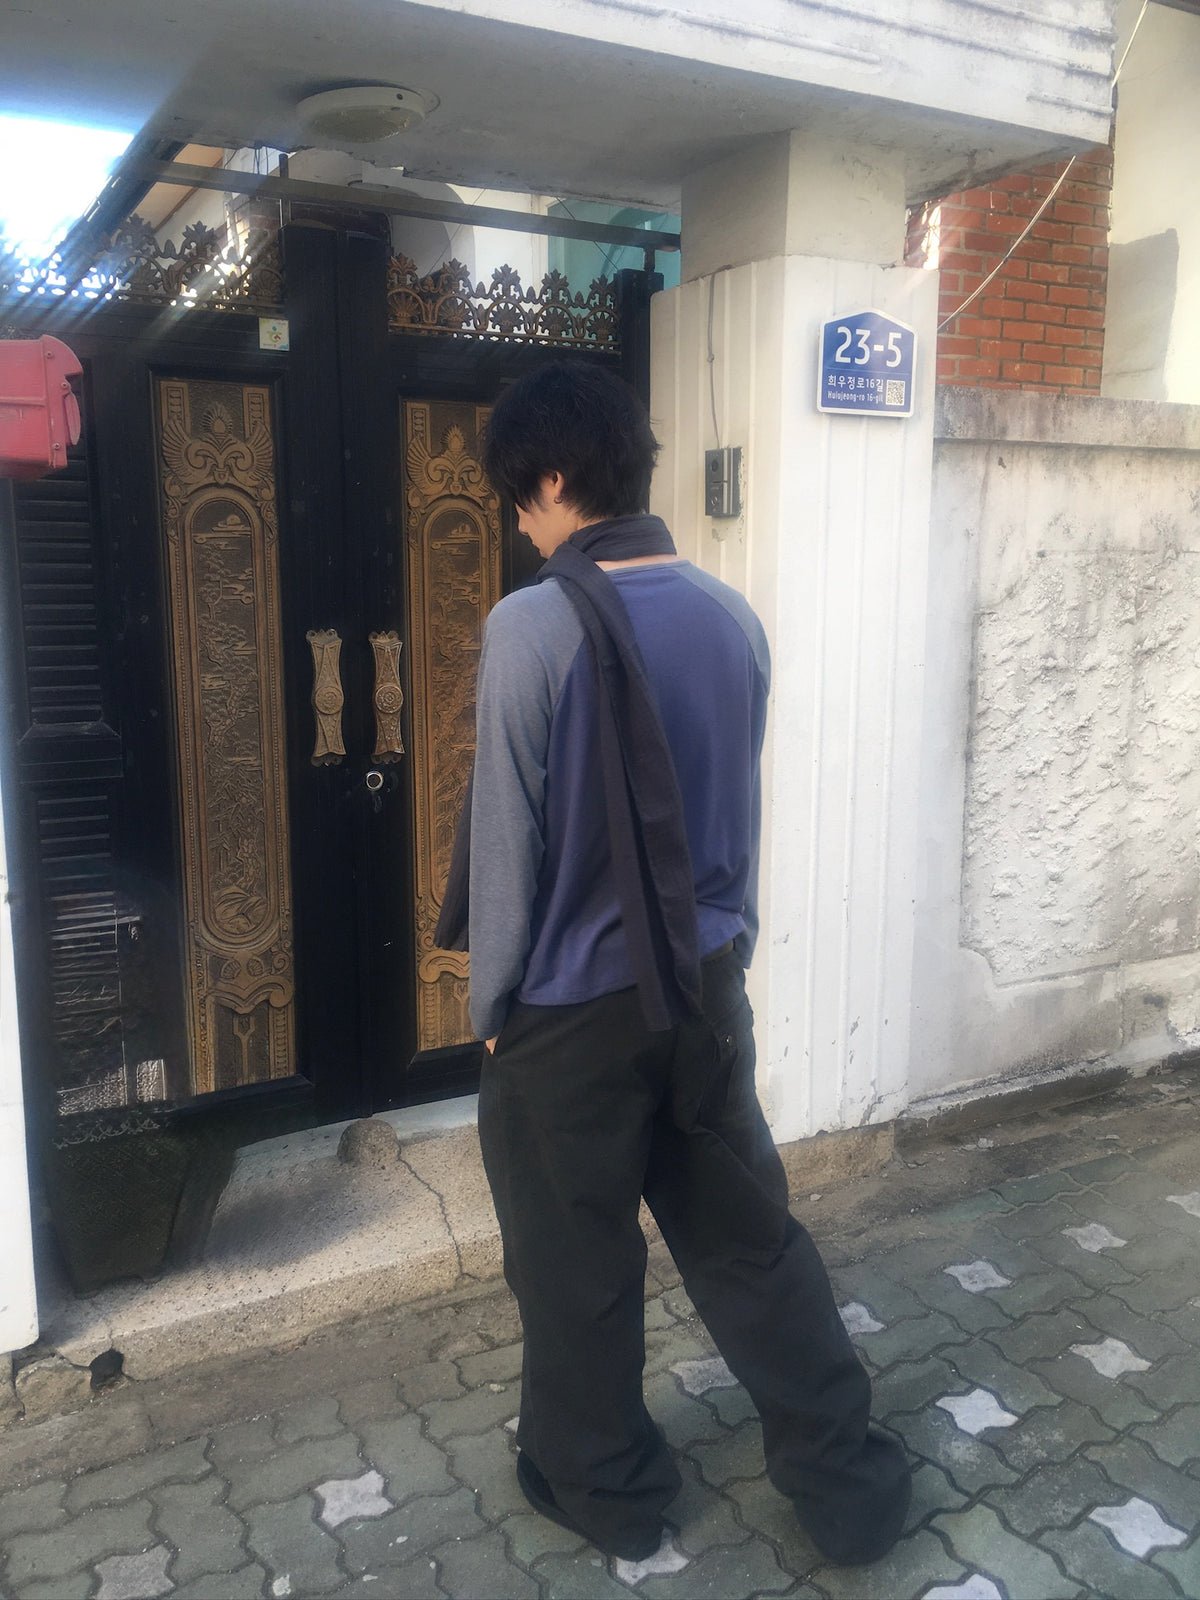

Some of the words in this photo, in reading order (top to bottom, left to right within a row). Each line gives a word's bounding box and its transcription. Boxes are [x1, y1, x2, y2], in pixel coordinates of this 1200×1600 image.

[835, 326, 902, 368] 23-5
[828, 374, 884, 392] 희우정로16길
[867, 393, 884, 404] 16-gil
